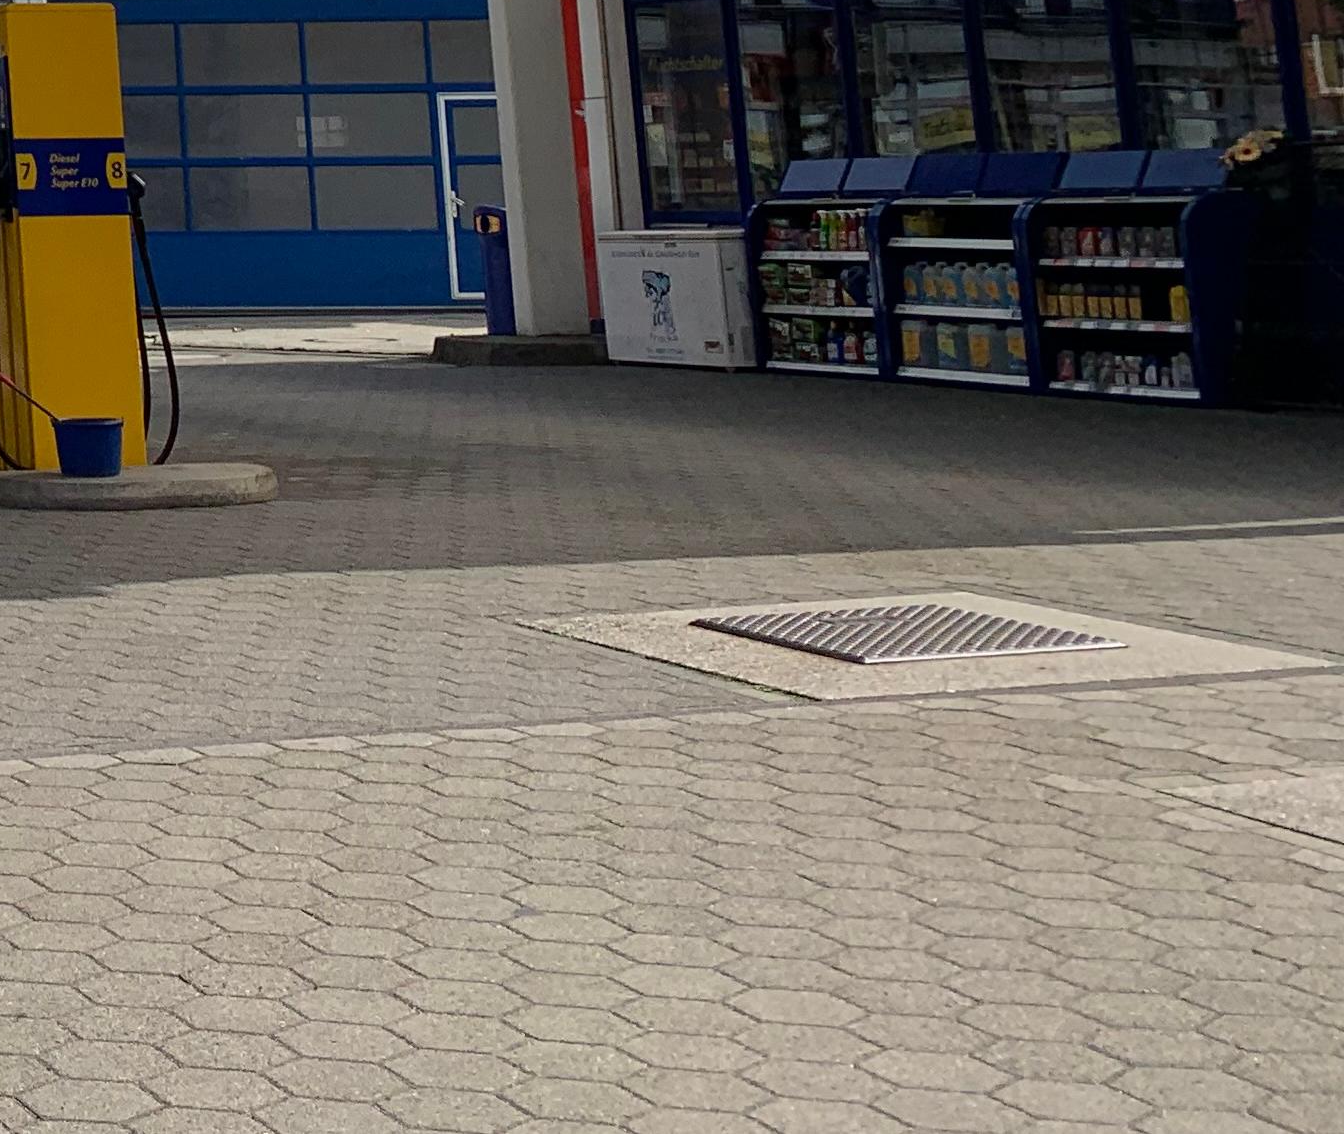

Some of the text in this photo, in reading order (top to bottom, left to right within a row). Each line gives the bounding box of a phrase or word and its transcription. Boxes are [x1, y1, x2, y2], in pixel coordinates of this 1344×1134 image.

[49, 153, 80, 164] Diesel
[19, 163, 31, 180] 7
[50, 167, 79, 178] Super
[112, 162, 124, 179] 8
[50, 177, 99, 191] Super E10
